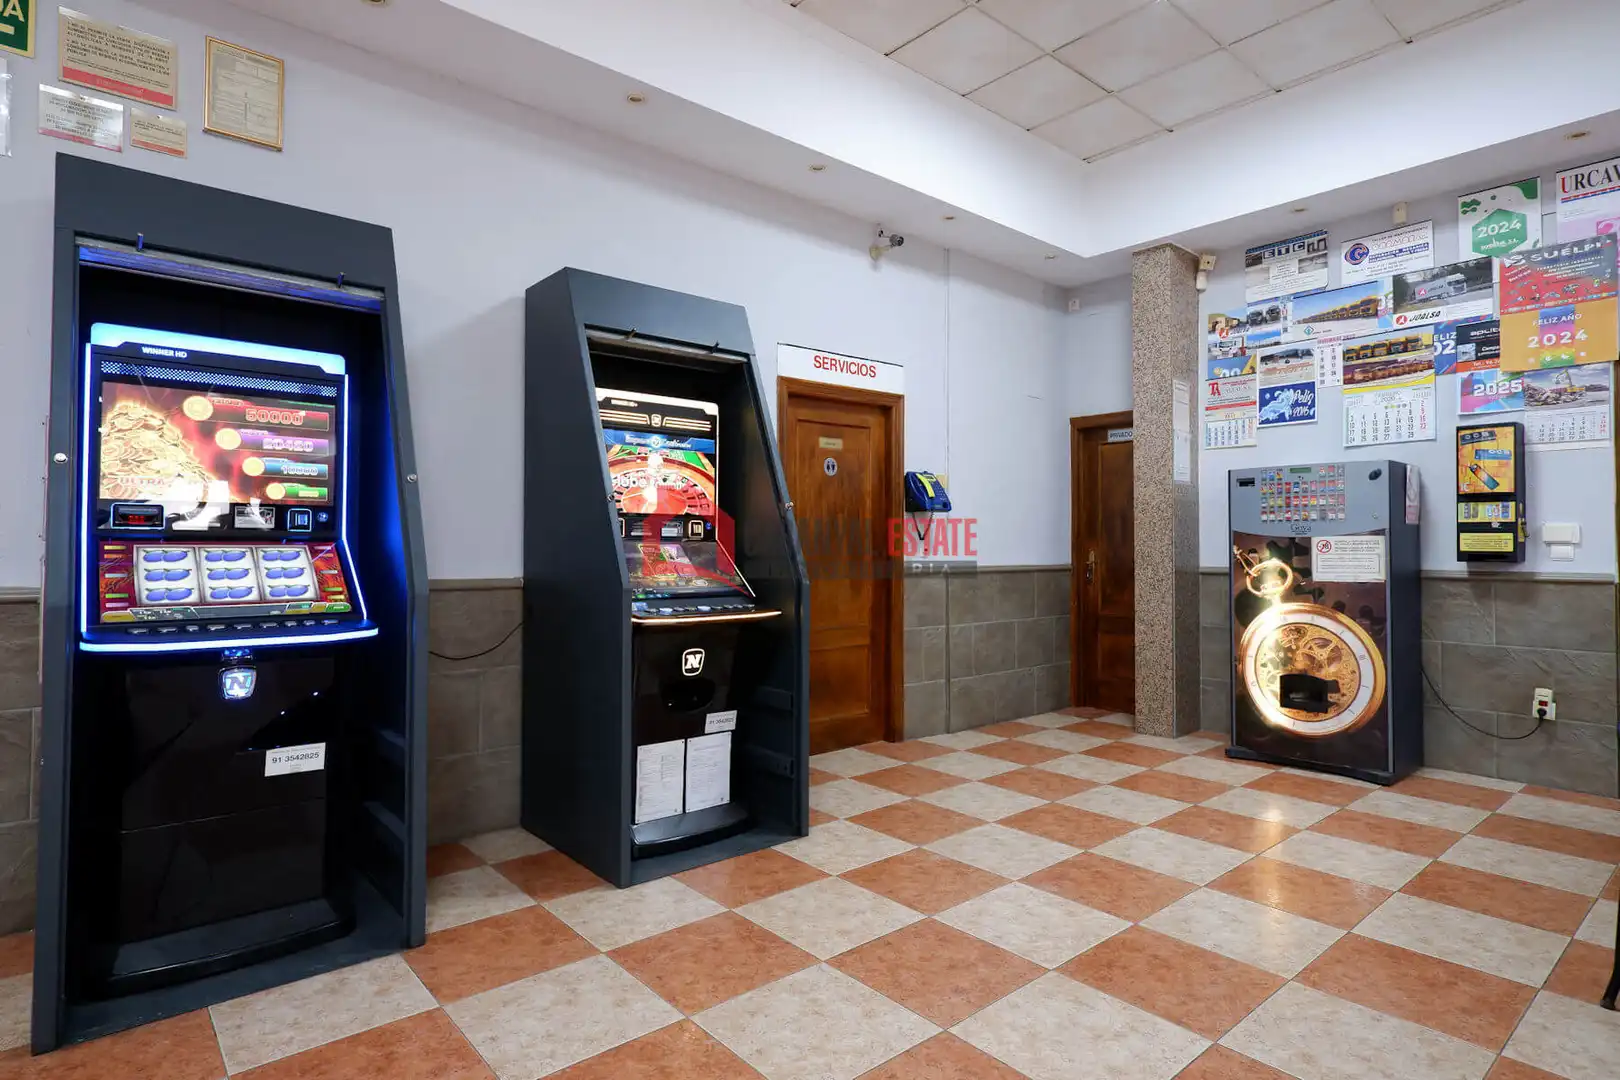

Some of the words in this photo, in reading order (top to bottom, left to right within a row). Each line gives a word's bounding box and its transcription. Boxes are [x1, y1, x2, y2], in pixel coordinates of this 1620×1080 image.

[1476, 219, 1522, 238] 2024
[1532, 315, 1558, 326] FELIZ
[1560, 312, 1582, 323] AÑO
[1434, 332, 1457, 341] ELIZ
[1527, 329, 1588, 348] 2024
[141, 346, 174, 357] WINNER
[175, 350, 188, 359] HD
[813, 354, 876, 378] SERVICIOS
[1473, 379, 1523, 396] 2025
[246, 407, 304, 426] 50000
[684, 654, 702, 669] N
